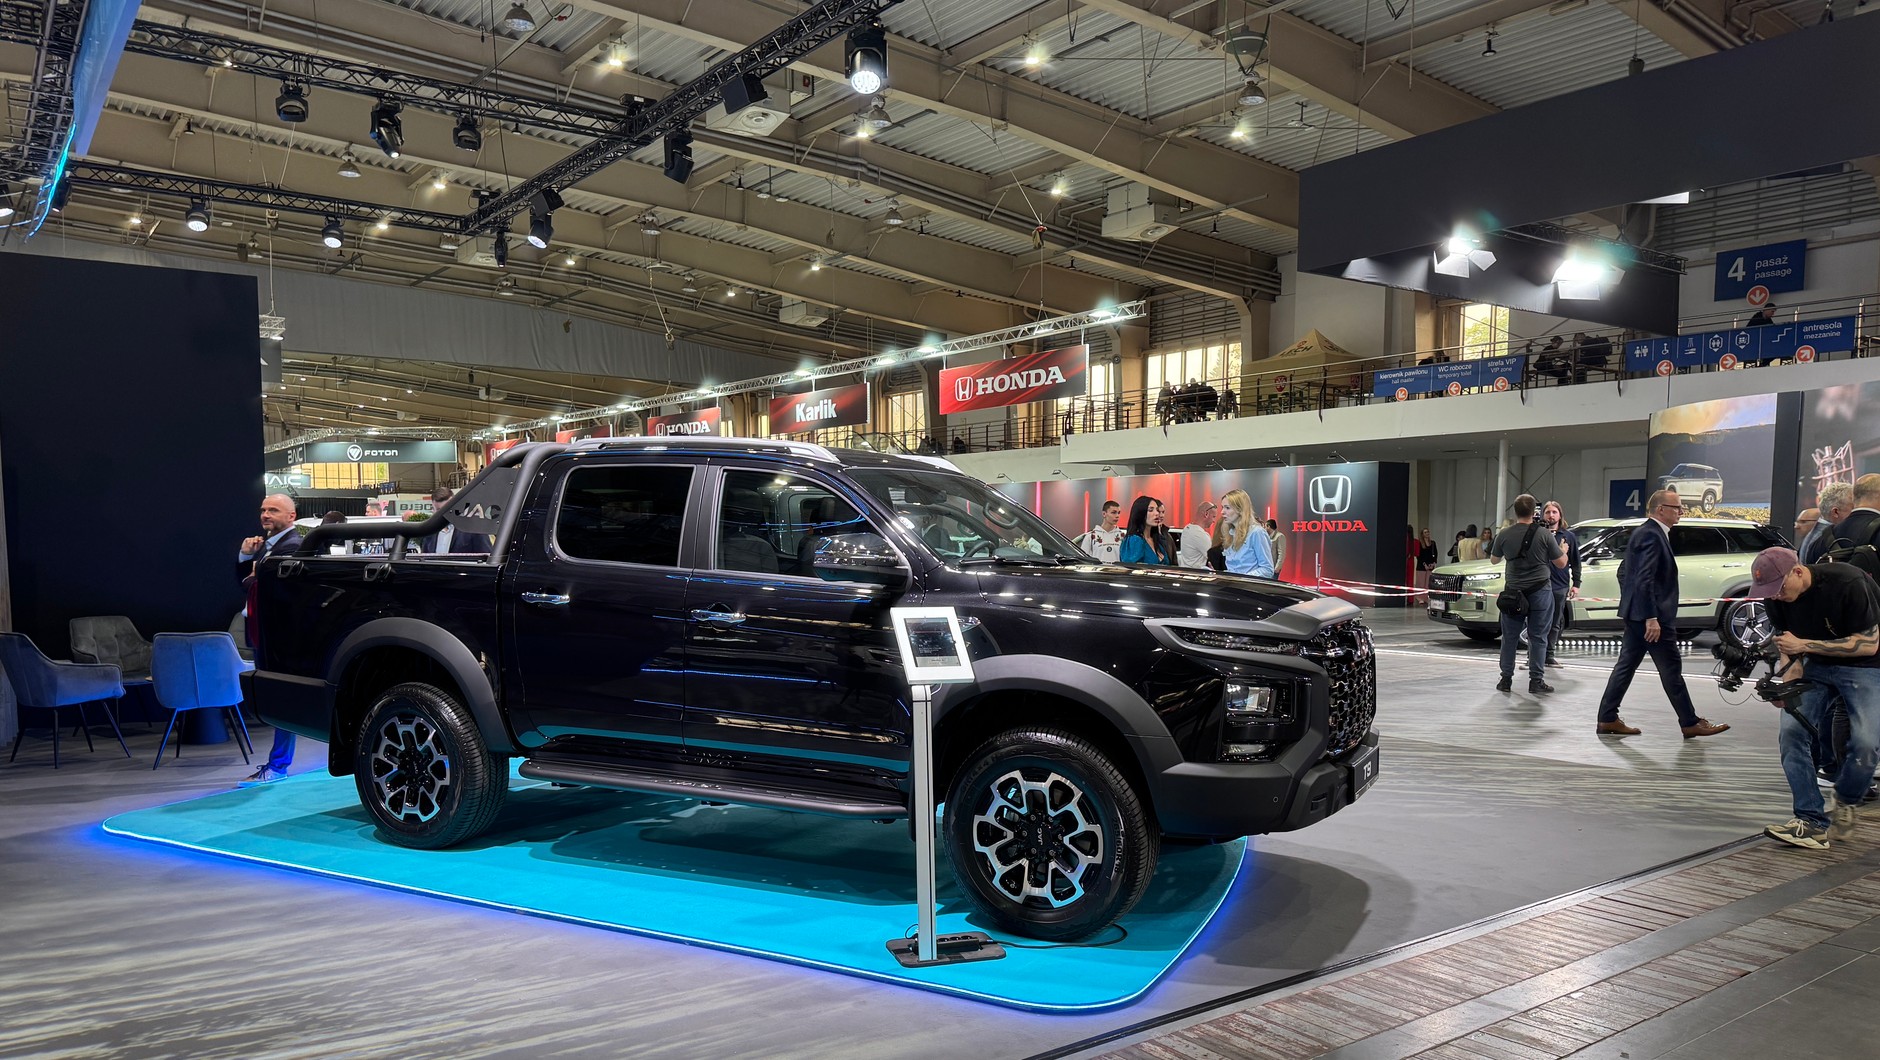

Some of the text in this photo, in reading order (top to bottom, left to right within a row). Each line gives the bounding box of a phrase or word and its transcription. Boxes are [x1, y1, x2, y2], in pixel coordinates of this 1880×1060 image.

[1727, 256, 1746, 282] 4
[1755, 254, 1789, 270] pasaż
[1754, 268, 1792, 281] passage
[1802, 321, 1842, 332] antresola
[1803, 331, 1841, 340] mezzanine
[1438, 365, 1449, 373] WC
[1487, 359, 1504, 367] strefa
[976, 365, 1066, 396] HONDA
[1379, 369, 1429, 380] kierownik pawilonu
[795, 399, 838, 423] Karlik
[666, 420, 711, 437] HONDA
[364, 449, 399, 457] FOTON
[1625, 488, 1641, 511] 4
[455, 502, 502, 520] JAC
[1292, 519, 1368, 532] HONDA
[1363, 761, 1372, 780] T9
